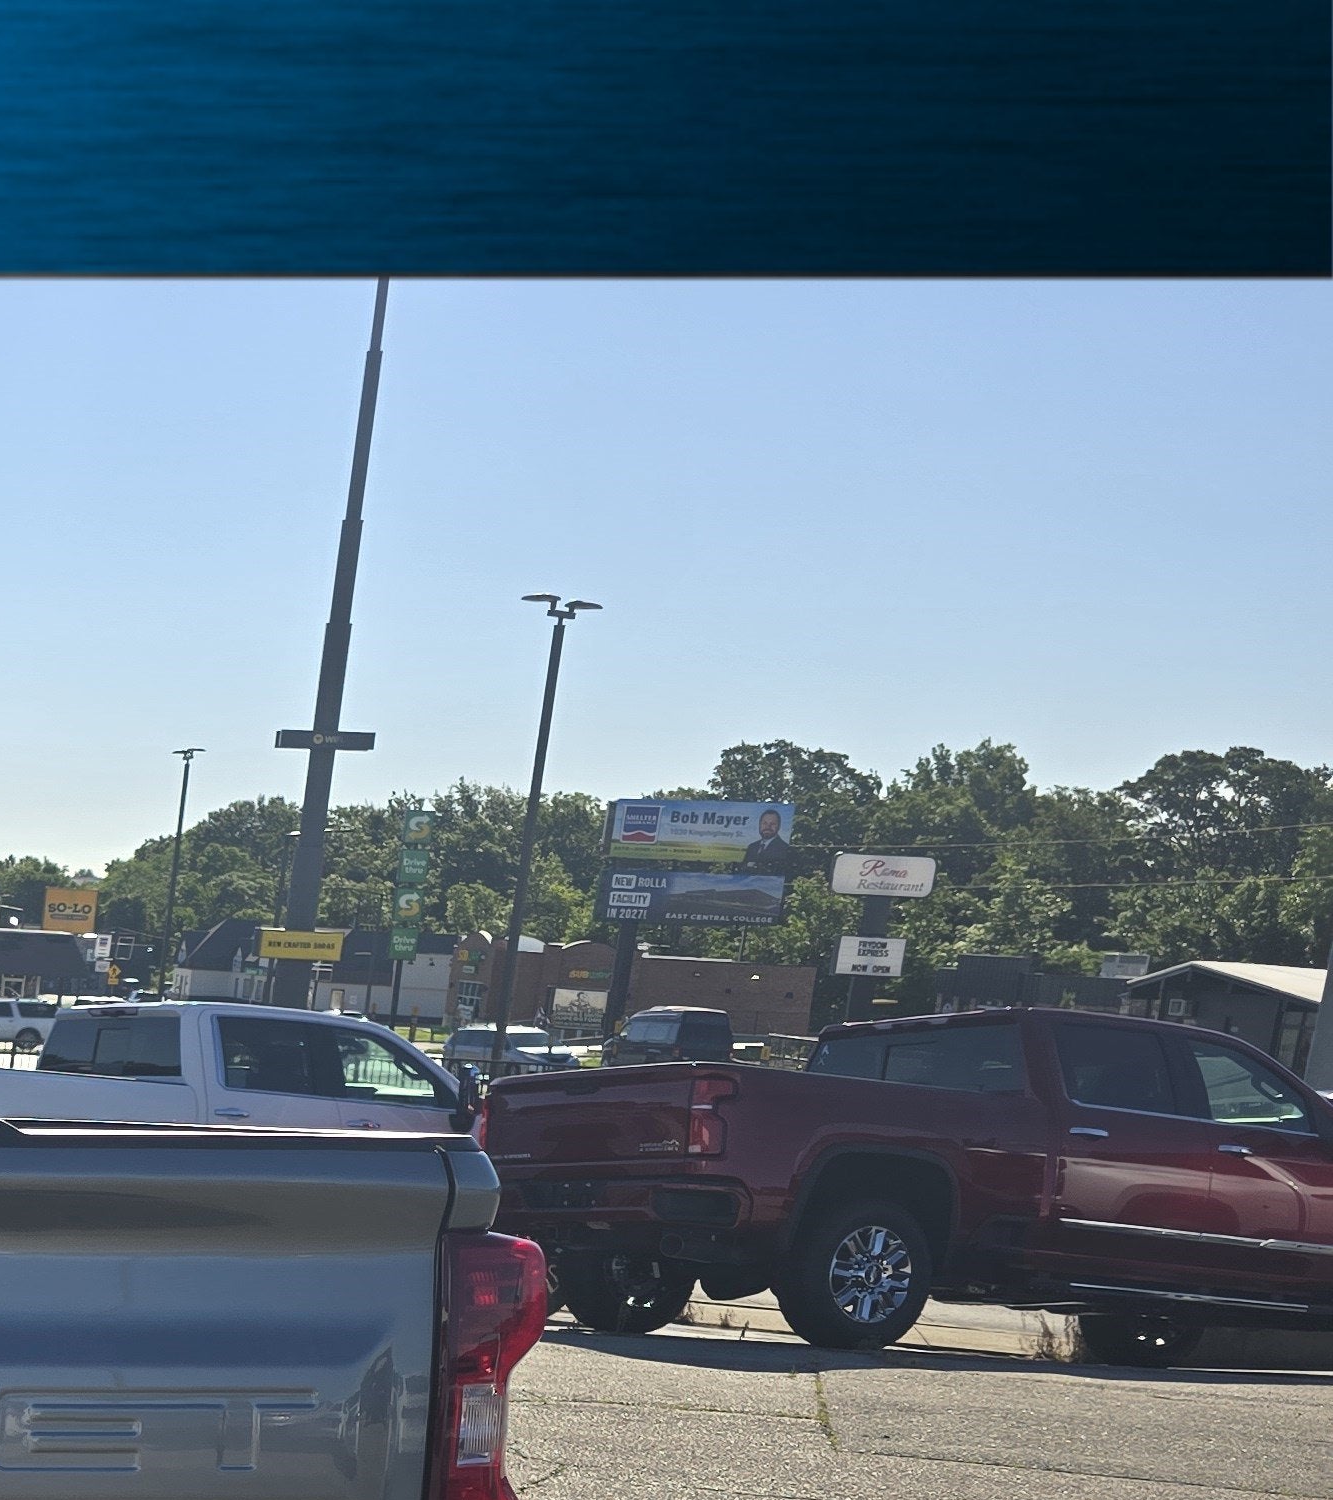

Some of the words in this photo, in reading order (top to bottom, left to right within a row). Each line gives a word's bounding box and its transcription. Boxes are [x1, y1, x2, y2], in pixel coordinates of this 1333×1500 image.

[670, 811, 699, 824] Bob
[702, 812, 750, 828] Mayer
[403, 858, 427, 866] Drive
[405, 866, 424, 874] thru
[614, 876, 635, 887] NEW
[637, 877, 667, 888] ROLLA
[856, 879, 924, 892] Restaurant
[611, 893, 649, 905] FACILITY
[48, 902, 93, 915] SO-LO
[606, 908, 617, 918] IN
[690, 913, 730, 922] CENTRAL
[733, 915, 773, 924] COLLEGE
[393, 936, 417, 944] Drive
[394, 944, 414, 952] thru
[857, 949, 889, 958] EXPRESS
[851, 964, 868, 972] NOW
[872, 965, 891, 974] OPEN
